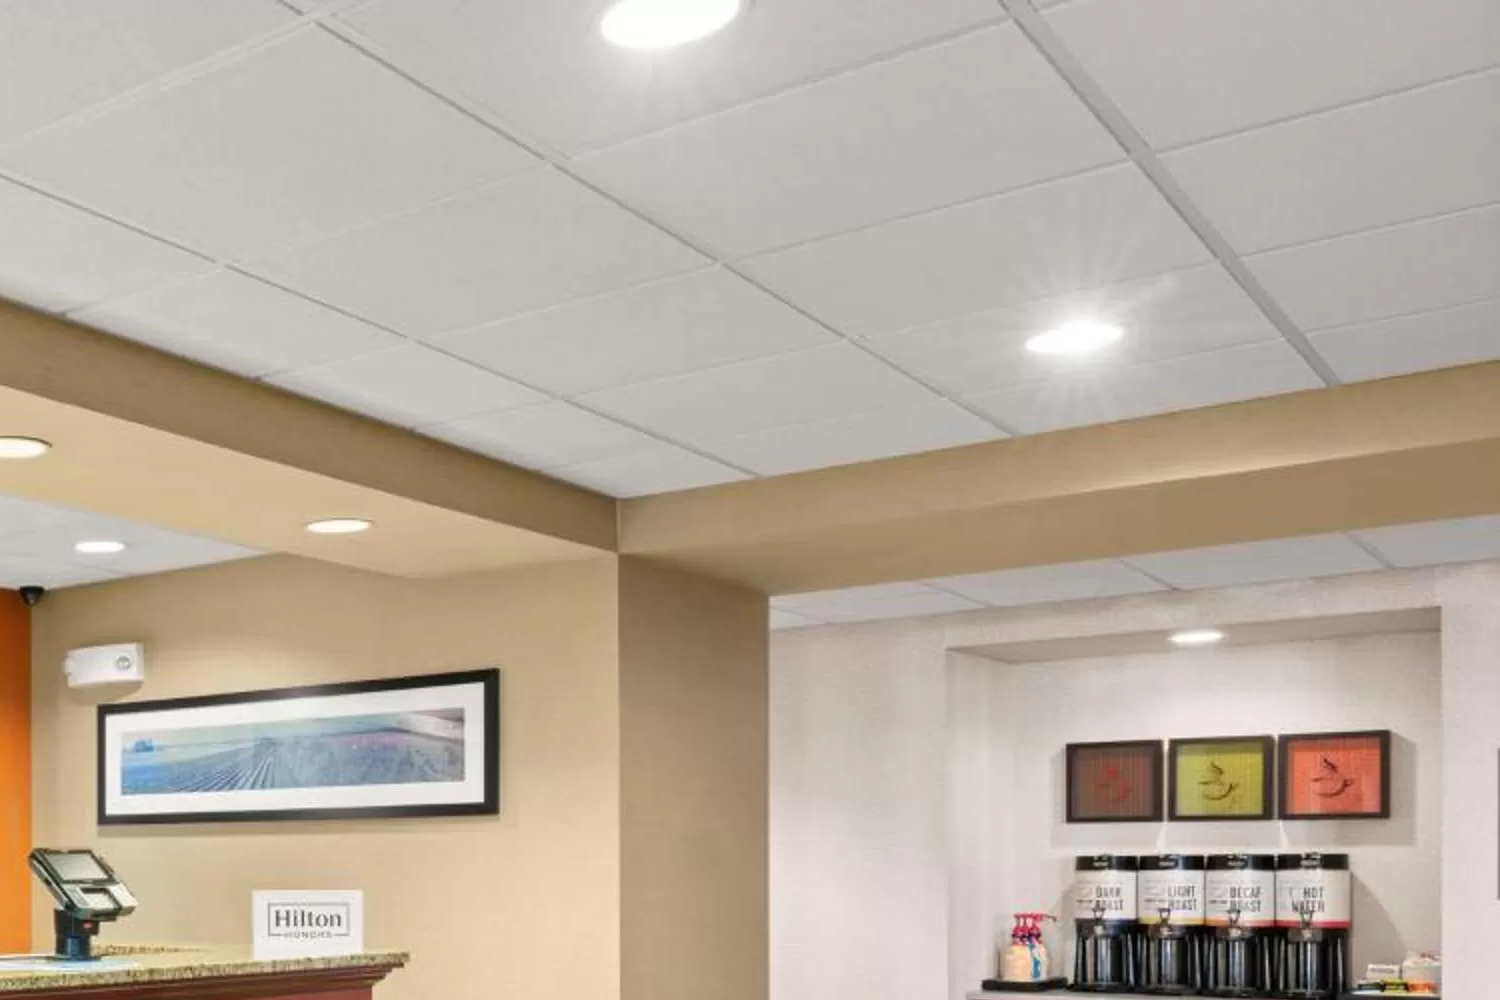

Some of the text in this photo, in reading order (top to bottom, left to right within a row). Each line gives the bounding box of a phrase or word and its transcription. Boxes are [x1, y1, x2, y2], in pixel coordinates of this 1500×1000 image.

[1167, 885, 1196, 898] LIGHT
[1229, 886, 1261, 898] DECAF
[1303, 887, 1324, 899] HOT
[275, 909, 342, 927] Hilton
